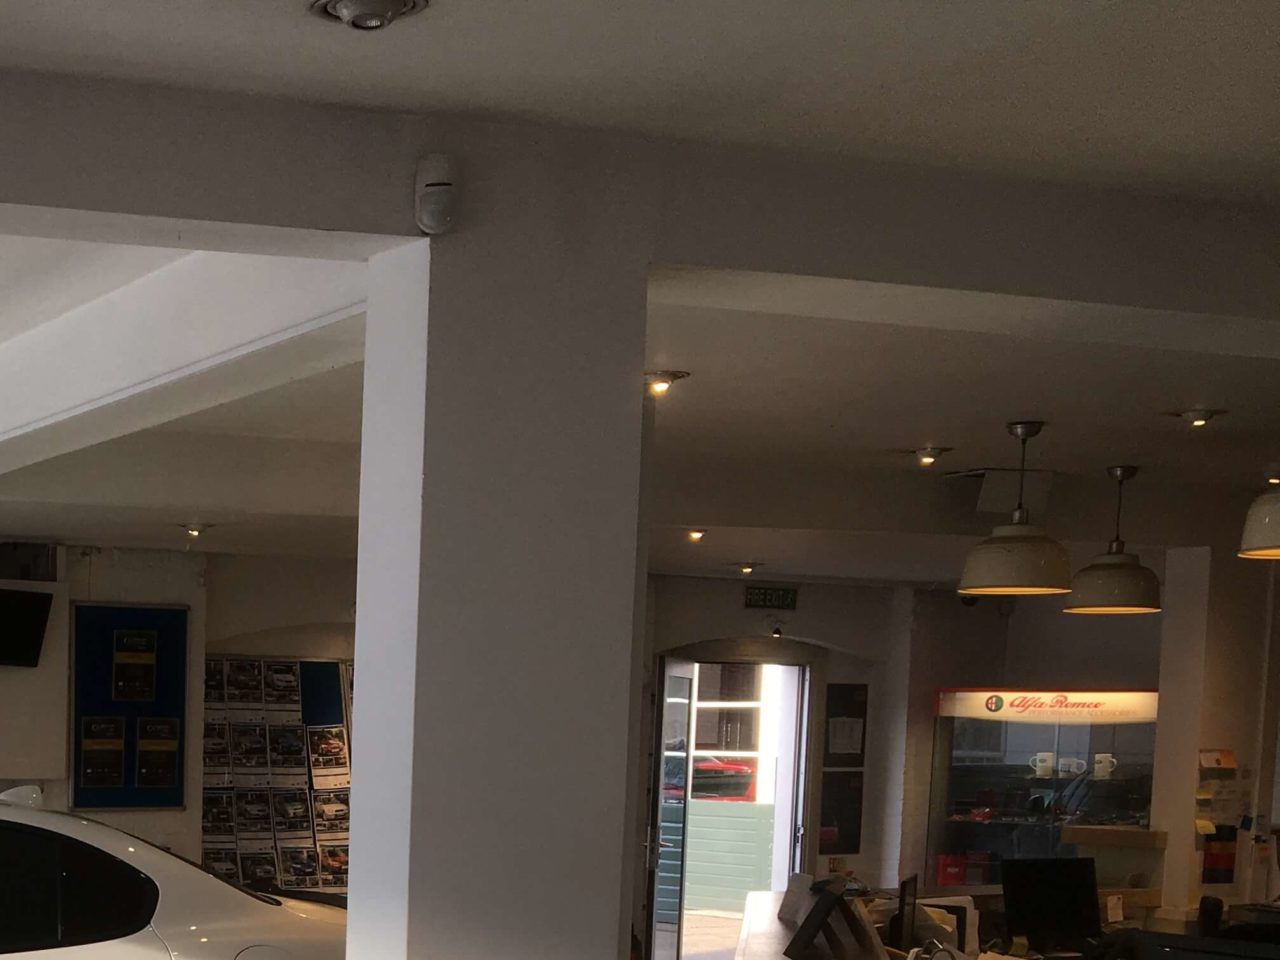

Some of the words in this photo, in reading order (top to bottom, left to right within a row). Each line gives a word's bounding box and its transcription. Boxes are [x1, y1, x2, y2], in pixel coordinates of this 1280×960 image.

[746, 588, 765, 605] FIRE
[766, 589, 783, 607] EXIT
[1009, 696, 1046, 713] Alfa
[1048, 695, 1104, 710] Romeo
